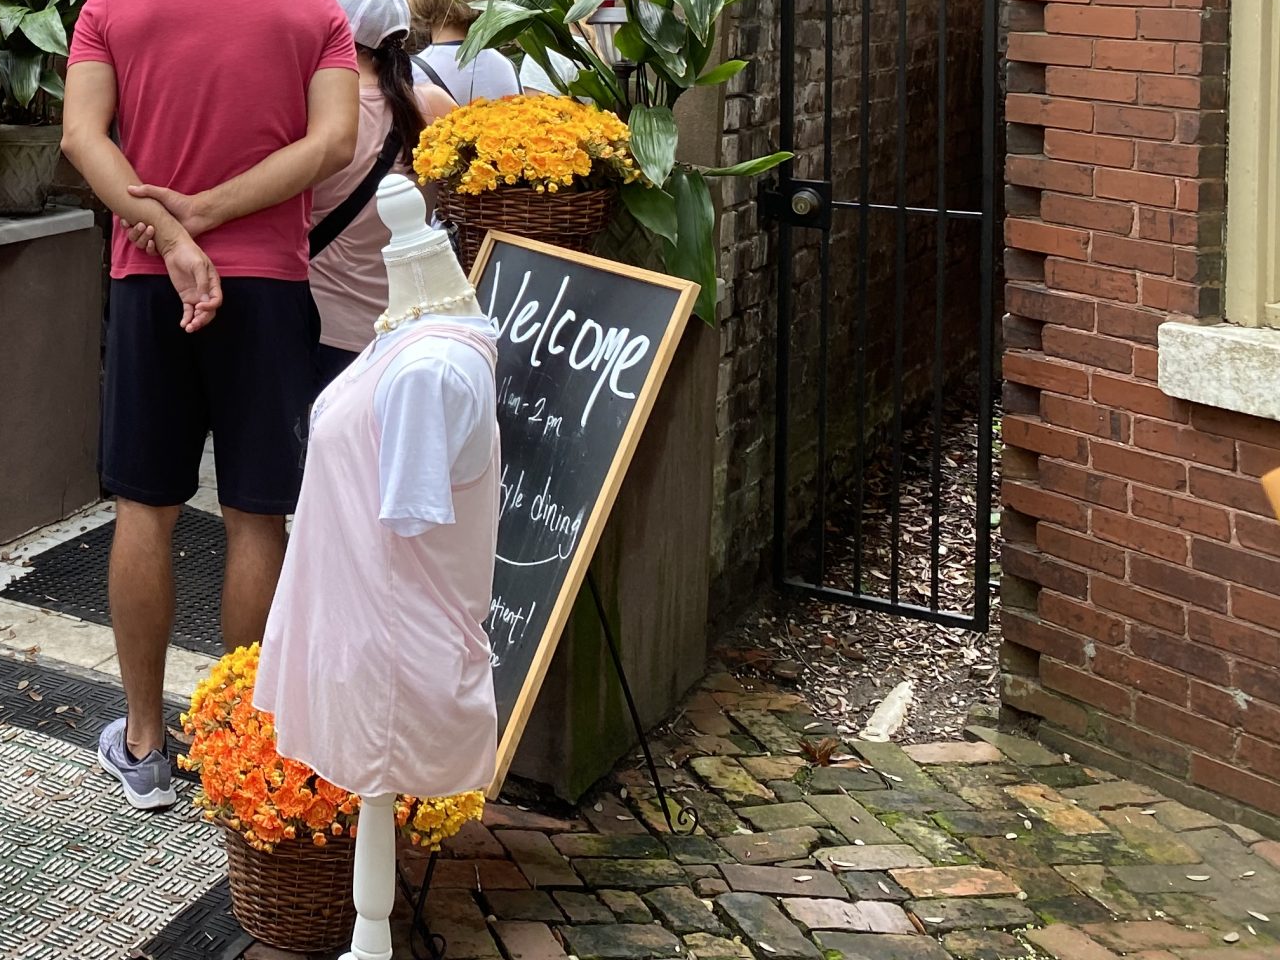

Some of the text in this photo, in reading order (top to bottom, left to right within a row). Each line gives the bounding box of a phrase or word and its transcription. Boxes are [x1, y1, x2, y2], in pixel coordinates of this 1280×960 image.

[488, 261, 650, 428] Welcome
[531, 476, 583, 559] dining
[490, 596, 536, 644] atient!
